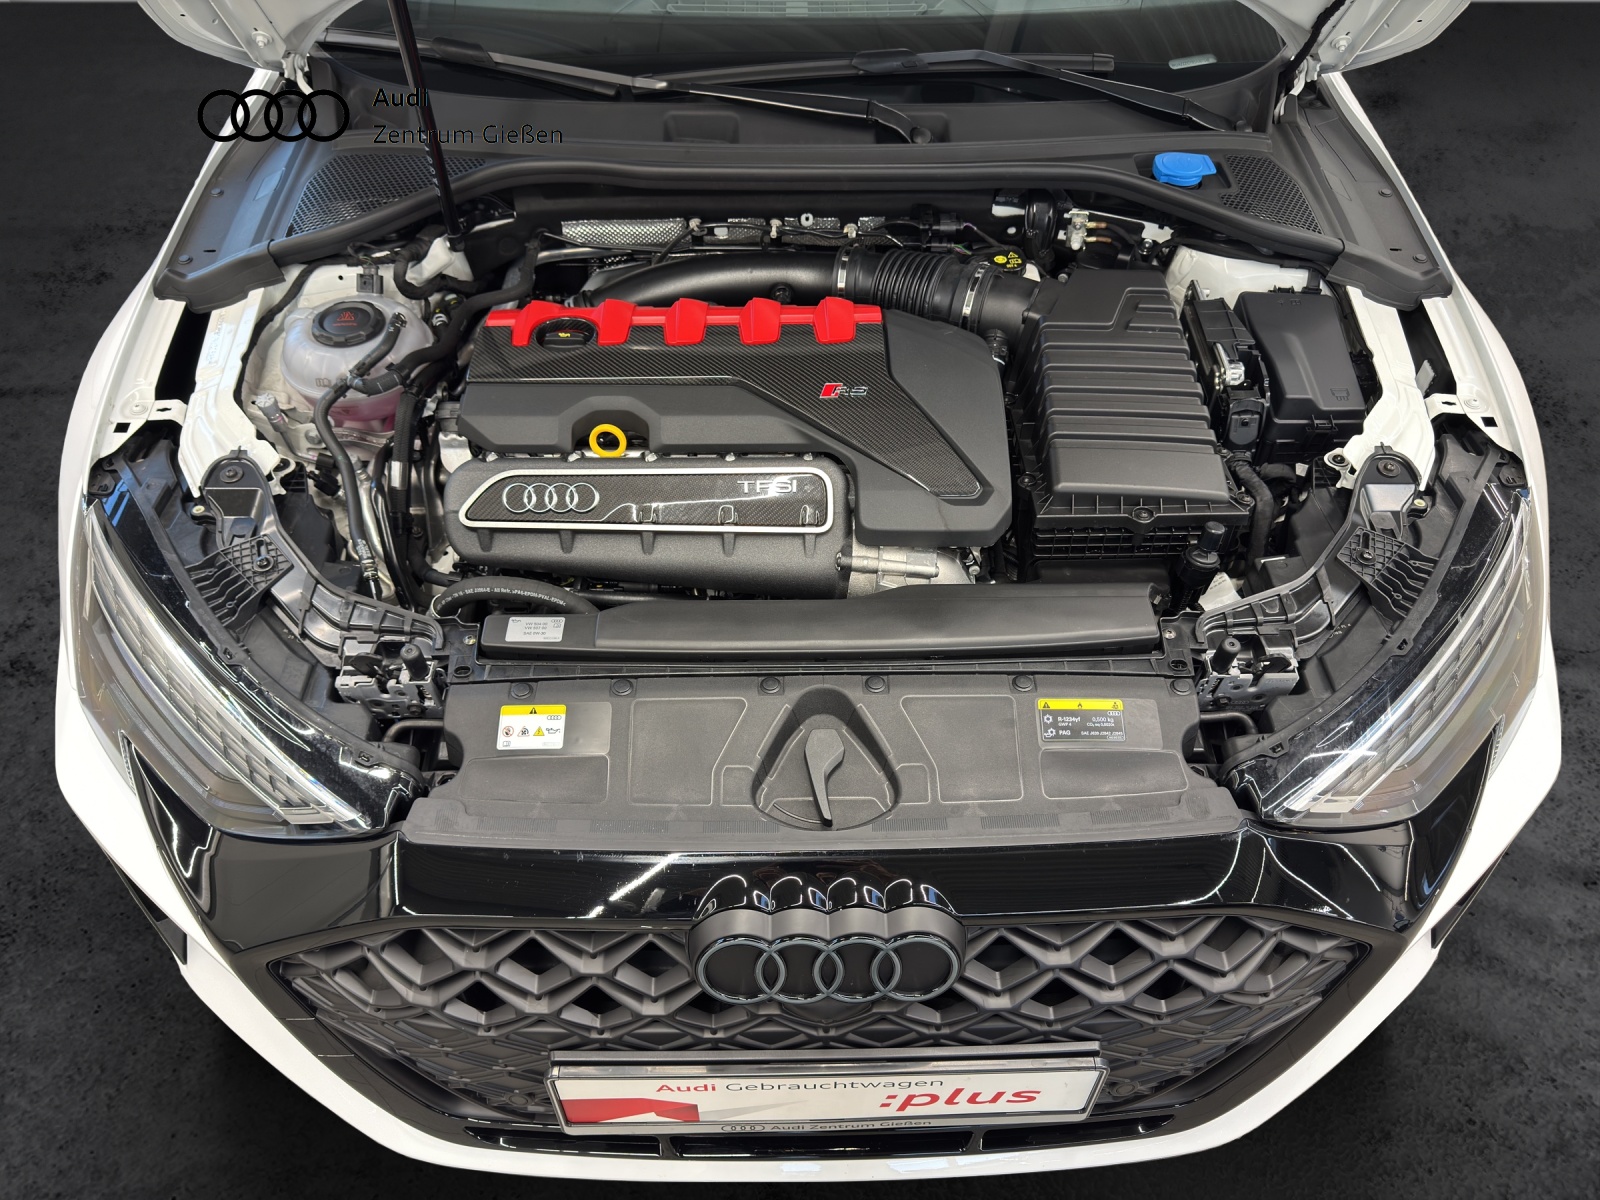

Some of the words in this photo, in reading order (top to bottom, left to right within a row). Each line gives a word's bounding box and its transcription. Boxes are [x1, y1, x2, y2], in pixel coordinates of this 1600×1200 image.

[737, 479, 797, 494] TFSI
[656, 1083, 716, 1093] Audi
[725, 1080, 944, 1092] Gebrauchtwagen
[879, 1087, 1042, 1112] :plus
[809, 1122, 875, 1130] Zentrum
